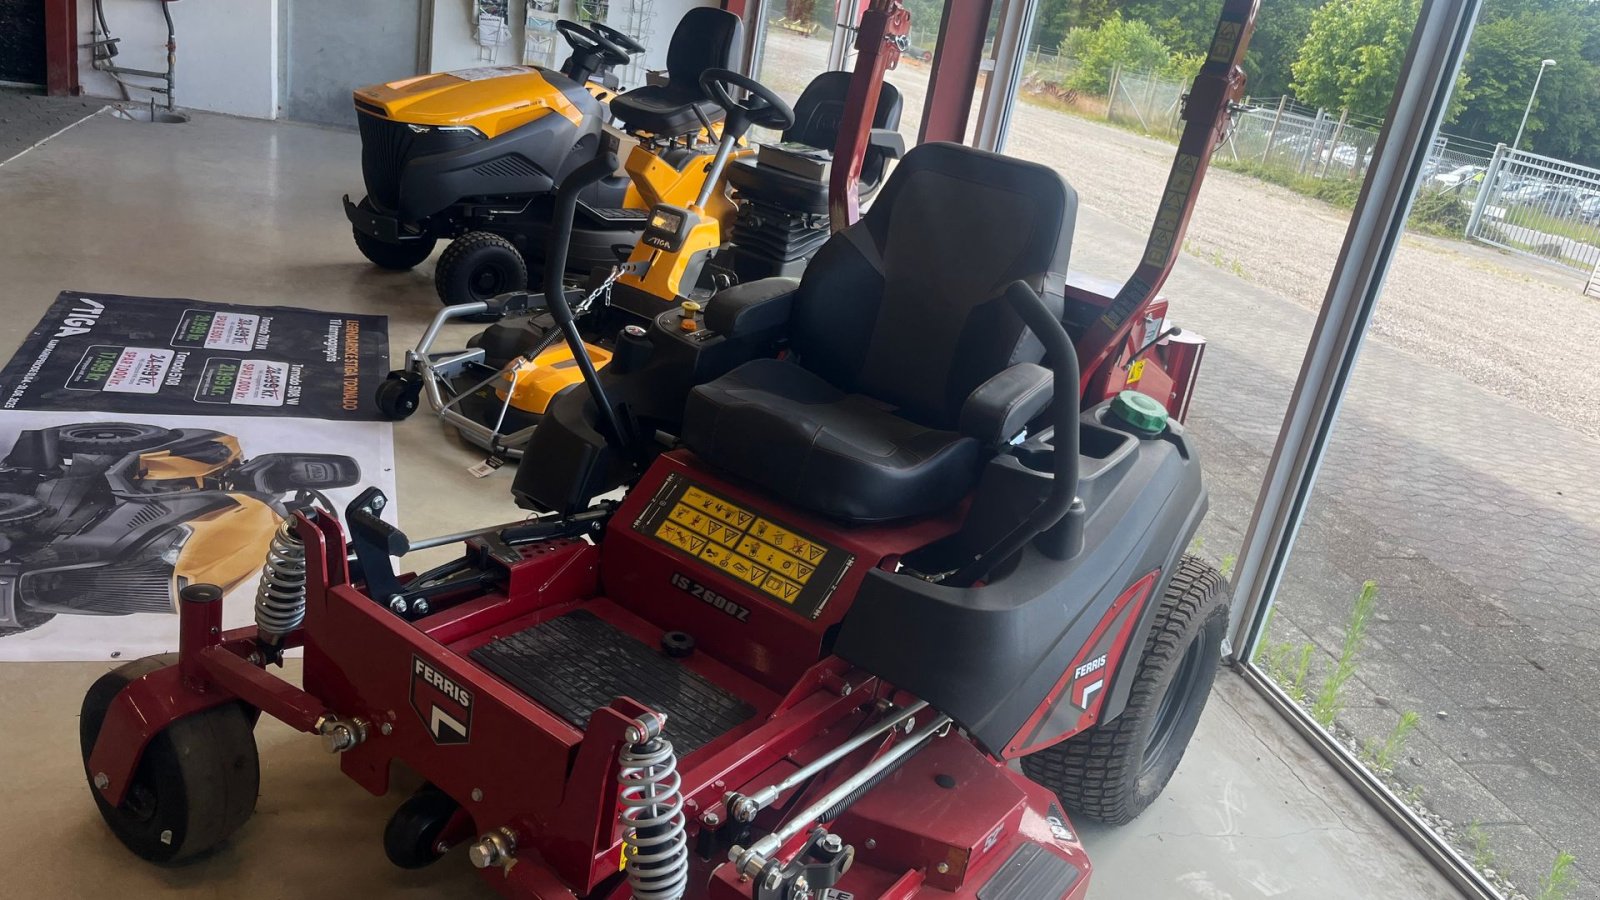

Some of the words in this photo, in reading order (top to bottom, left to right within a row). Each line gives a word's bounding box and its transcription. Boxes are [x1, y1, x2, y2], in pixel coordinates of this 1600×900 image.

[648, 237, 671, 249] STIGA
[54, 298, 105, 338] STIGA
[323, 325, 341, 362] kampagnepris
[90, 352, 118, 372] 17.999
[120, 351, 137, 364] SPAR
[171, 351, 190, 373] Tornado
[84, 372, 103, 382] kr.
[240, 363, 255, 375] SPAR
[289, 364, 304, 385] Tornado
[344, 359, 358, 377] STIGA
[136, 376, 152, 386] kr.
[165, 372, 182, 386] 5108
[211, 386, 228, 396] kr.
[261, 388, 275, 399] kr.
[343, 377, 358, 410] TORNADO
[671, 573, 693, 592] IS
[691, 584, 751, 624] 2600Z
[1075, 654, 1107, 680] FERRIS
[415, 659, 470, 707] FERRIS
